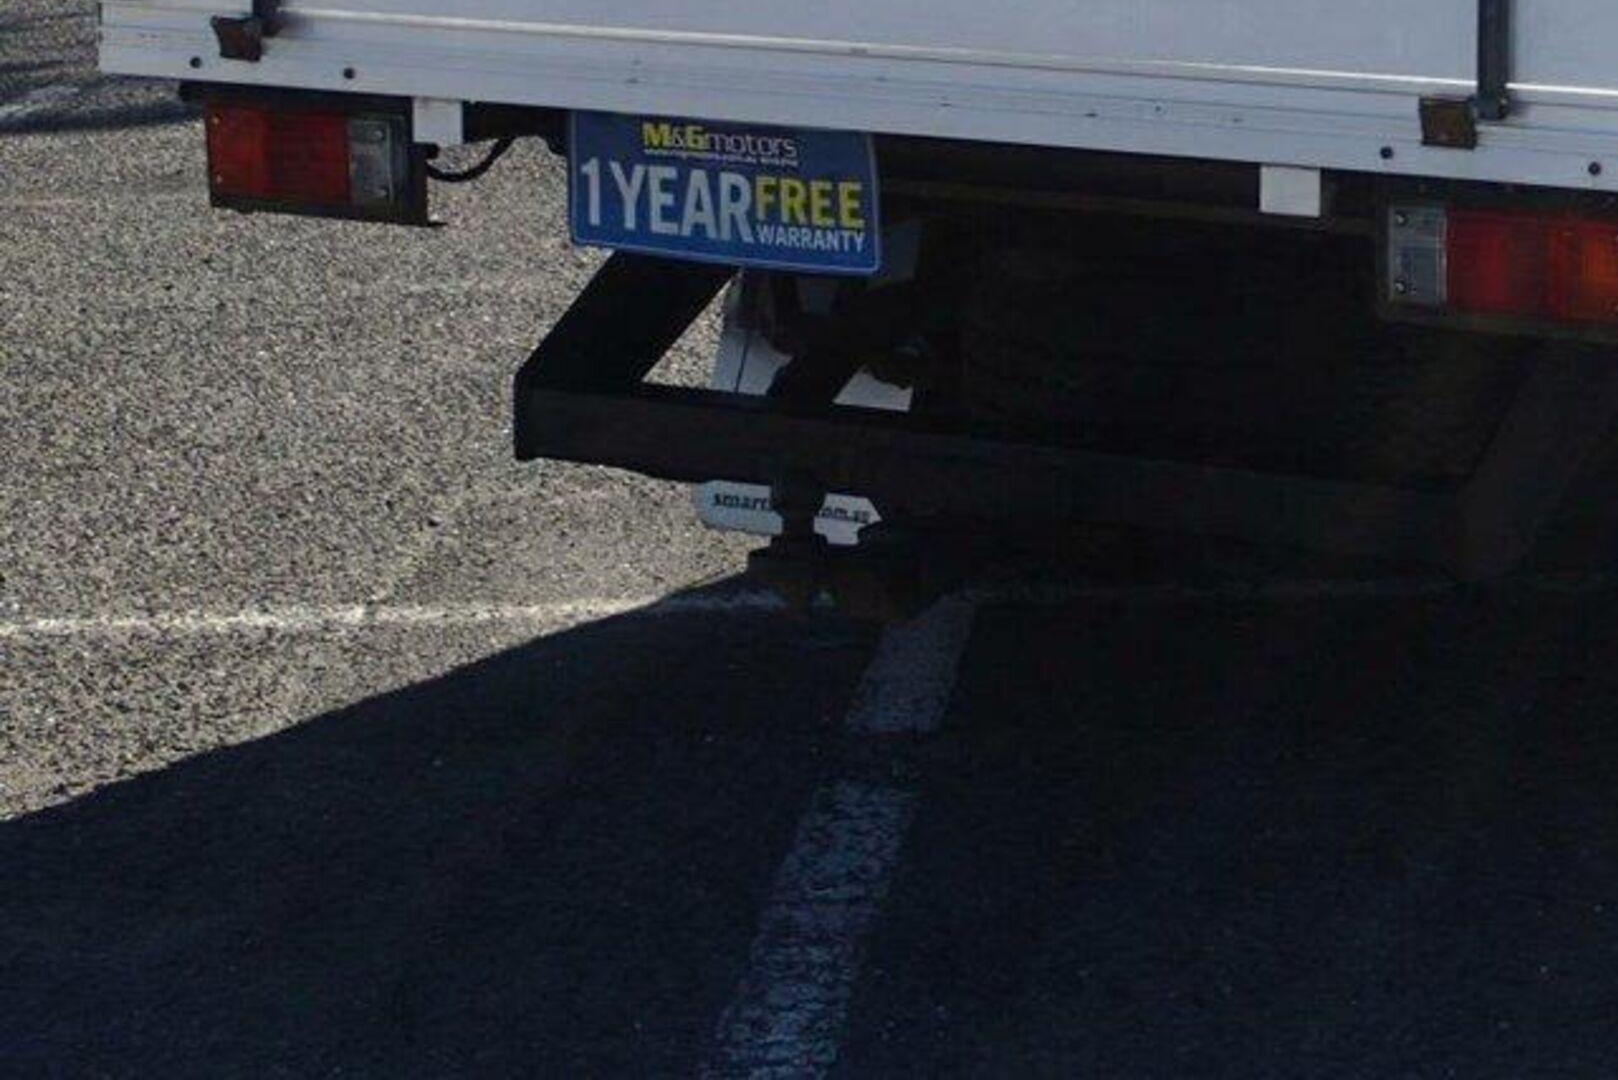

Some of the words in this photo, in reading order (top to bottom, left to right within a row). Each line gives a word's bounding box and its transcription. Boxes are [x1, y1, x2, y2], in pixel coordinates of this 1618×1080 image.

[642, 122, 798, 158] M&Gmotors
[580, 156, 600, 227] 1
[609, 161, 755, 244] YEAR
[755, 176, 866, 229] FREE
[755, 223, 866, 252] WARRANTY
